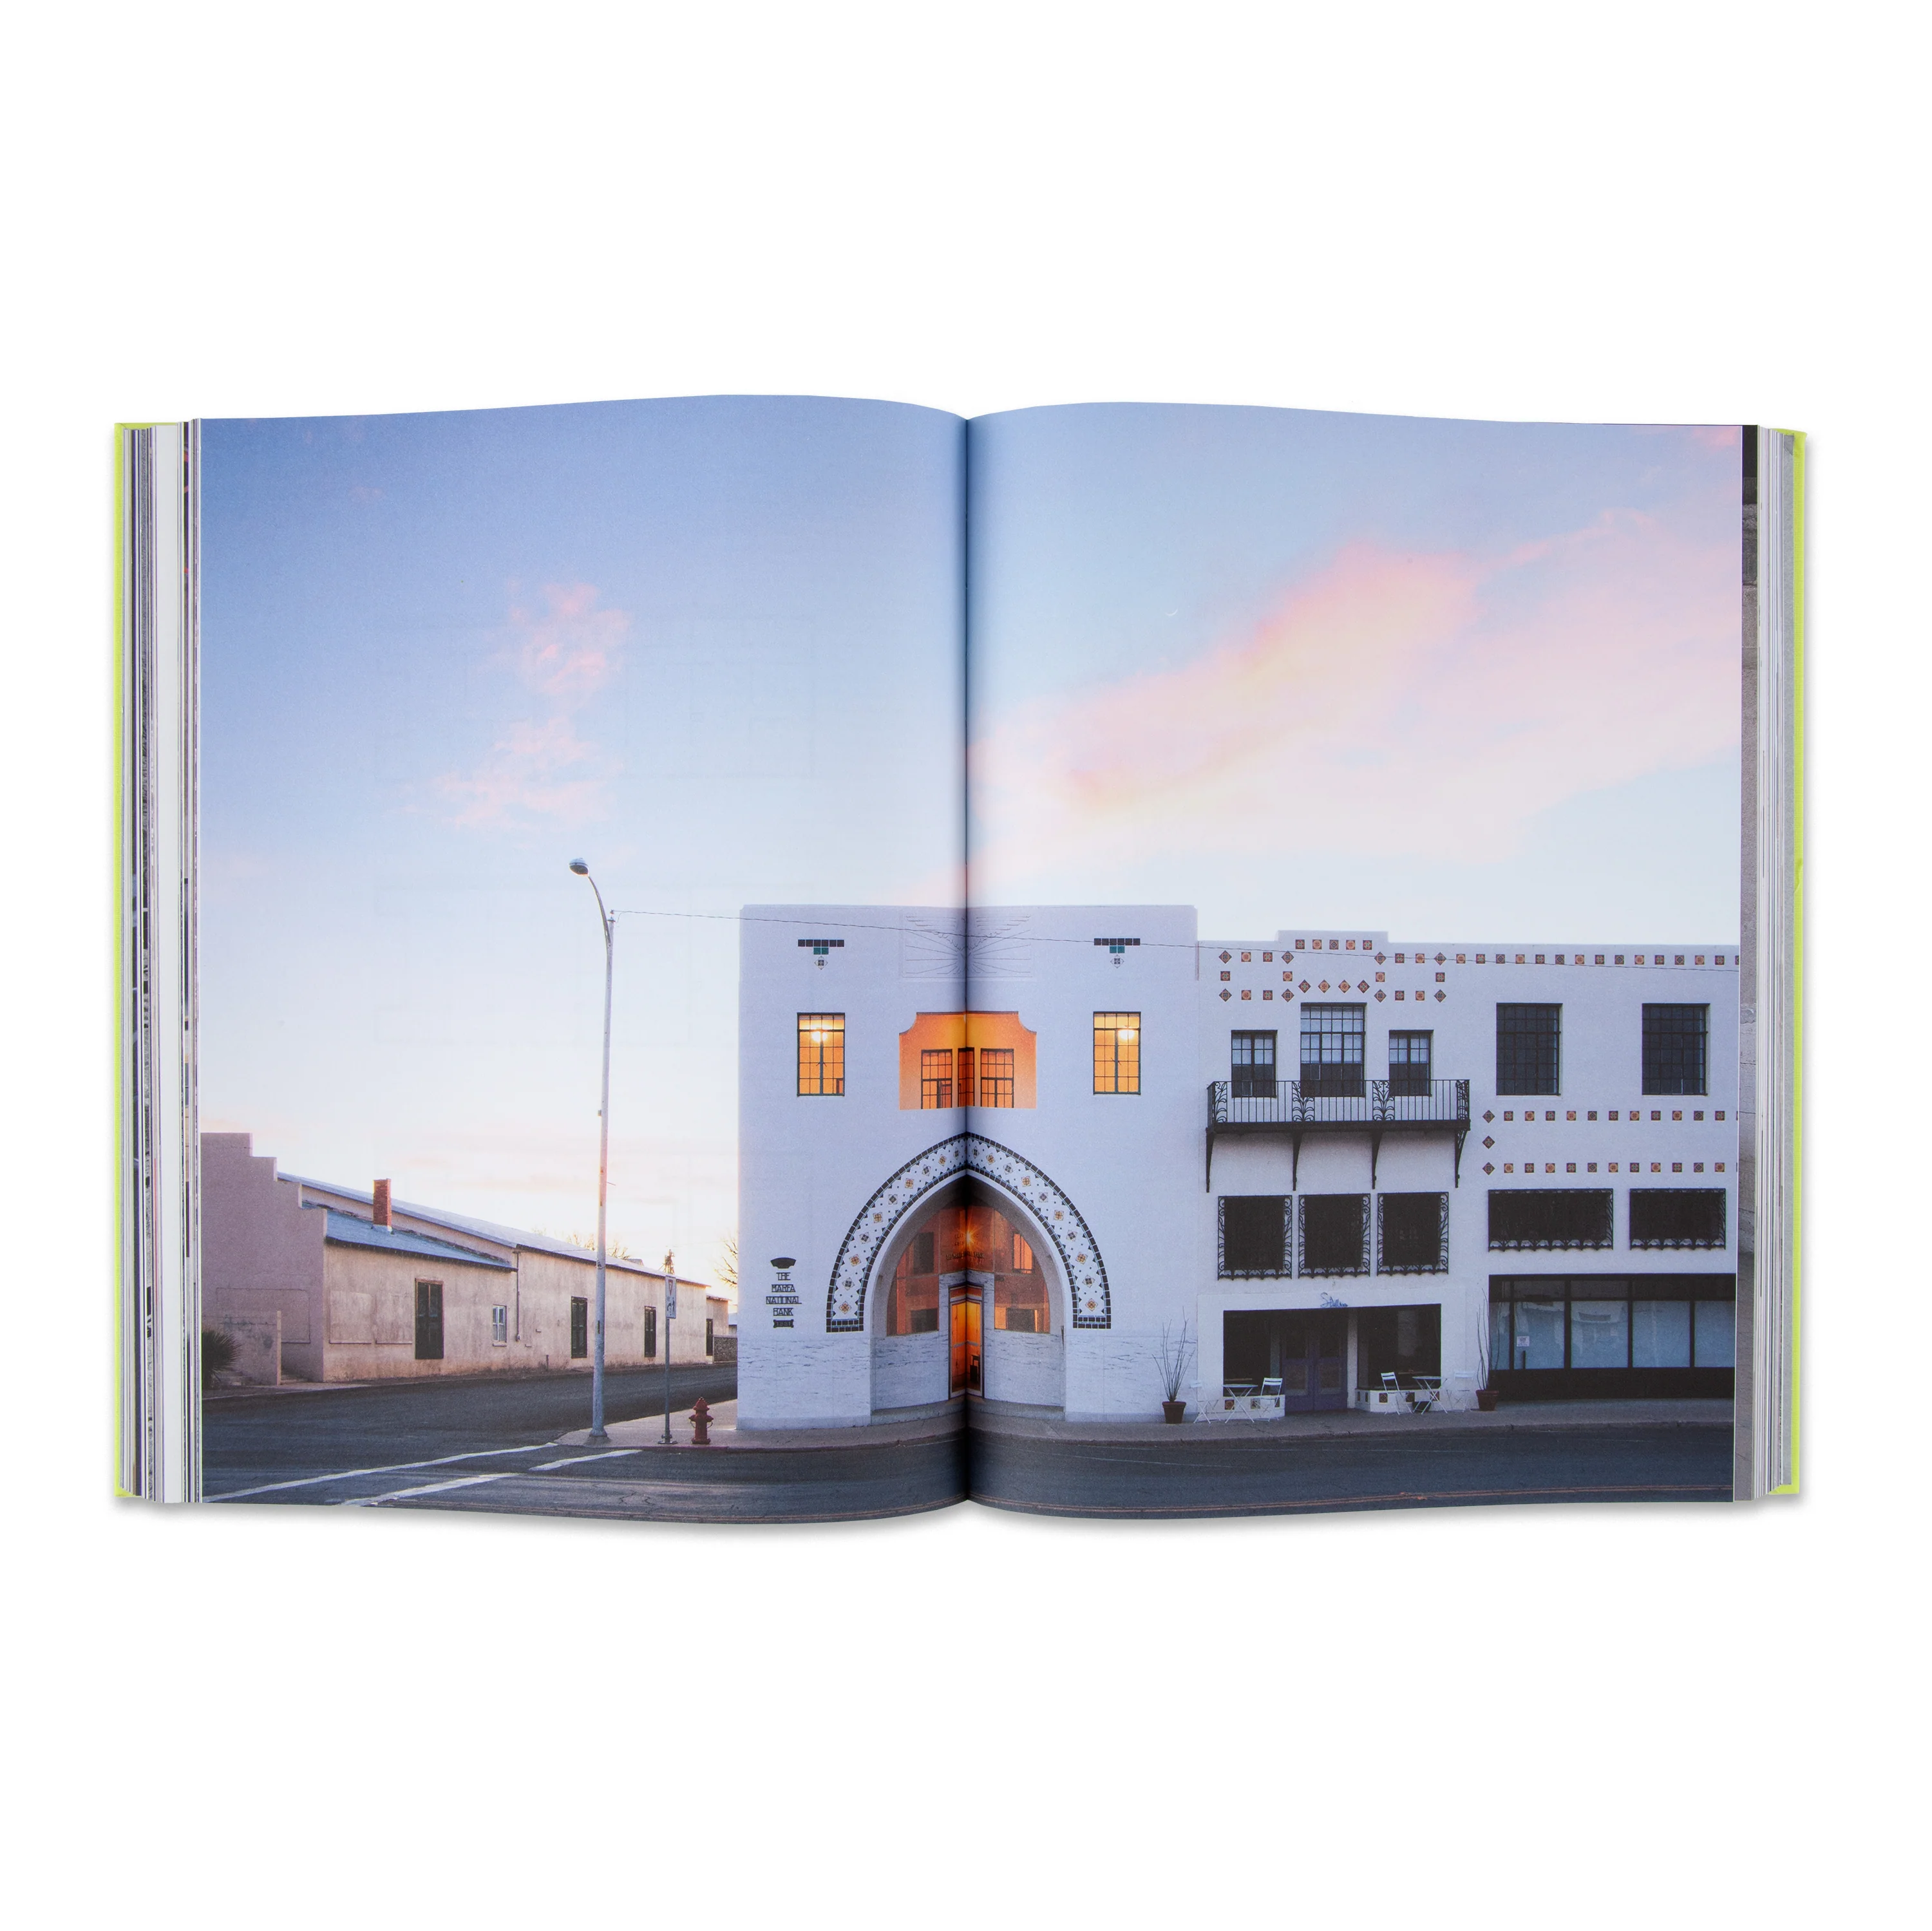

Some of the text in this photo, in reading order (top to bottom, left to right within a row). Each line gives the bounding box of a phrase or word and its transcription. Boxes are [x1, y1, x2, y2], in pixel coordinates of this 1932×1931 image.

[776, 1272, 791, 1281] THE
[772, 1284, 796, 1292] MARFA
[766, 1295, 802, 1305] NATIONAL
[773, 1308, 794, 1316] BANK
